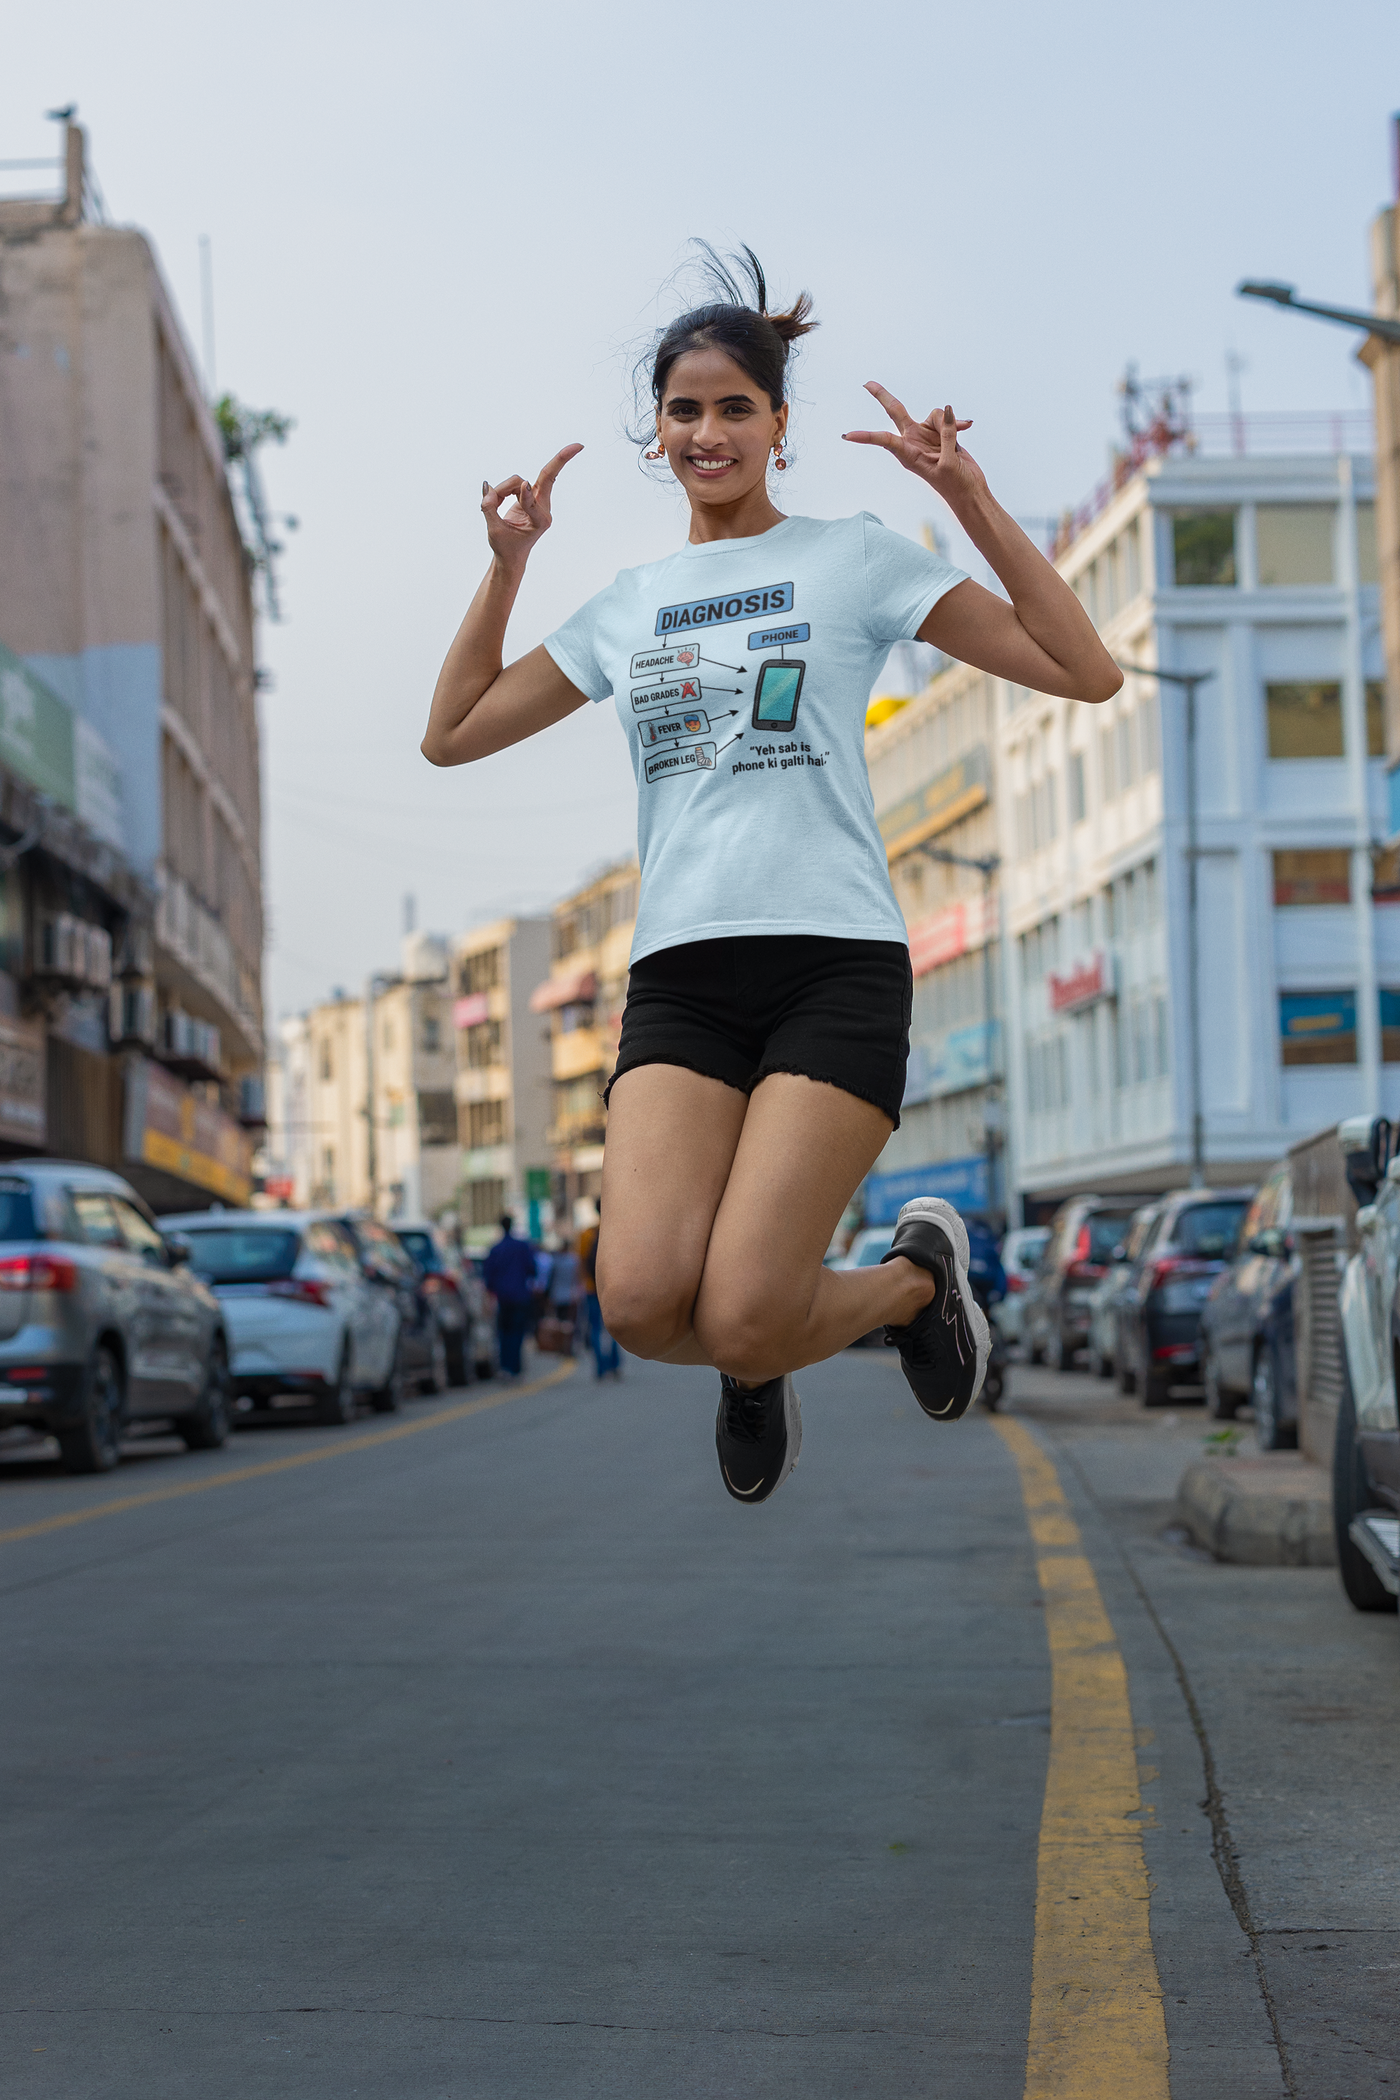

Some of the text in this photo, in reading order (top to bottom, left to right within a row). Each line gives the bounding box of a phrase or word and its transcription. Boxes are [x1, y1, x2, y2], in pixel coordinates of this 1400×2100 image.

[661, 589, 785, 630] DIAGNOSIS
[761, 630, 798, 643] PHONE
[636, 655, 674, 669] HEADACHE
[635, 689, 679, 705] BAD GRADES
[658, 723, 682, 734] FEVER
[779, 742, 797, 753] sab
[801, 742, 810, 752] is
[648, 755, 695, 775] BROKEN LEG
[732, 758, 765, 775] phone
[768, 757, 777, 768] ki
[781, 755, 804, 770] galti
